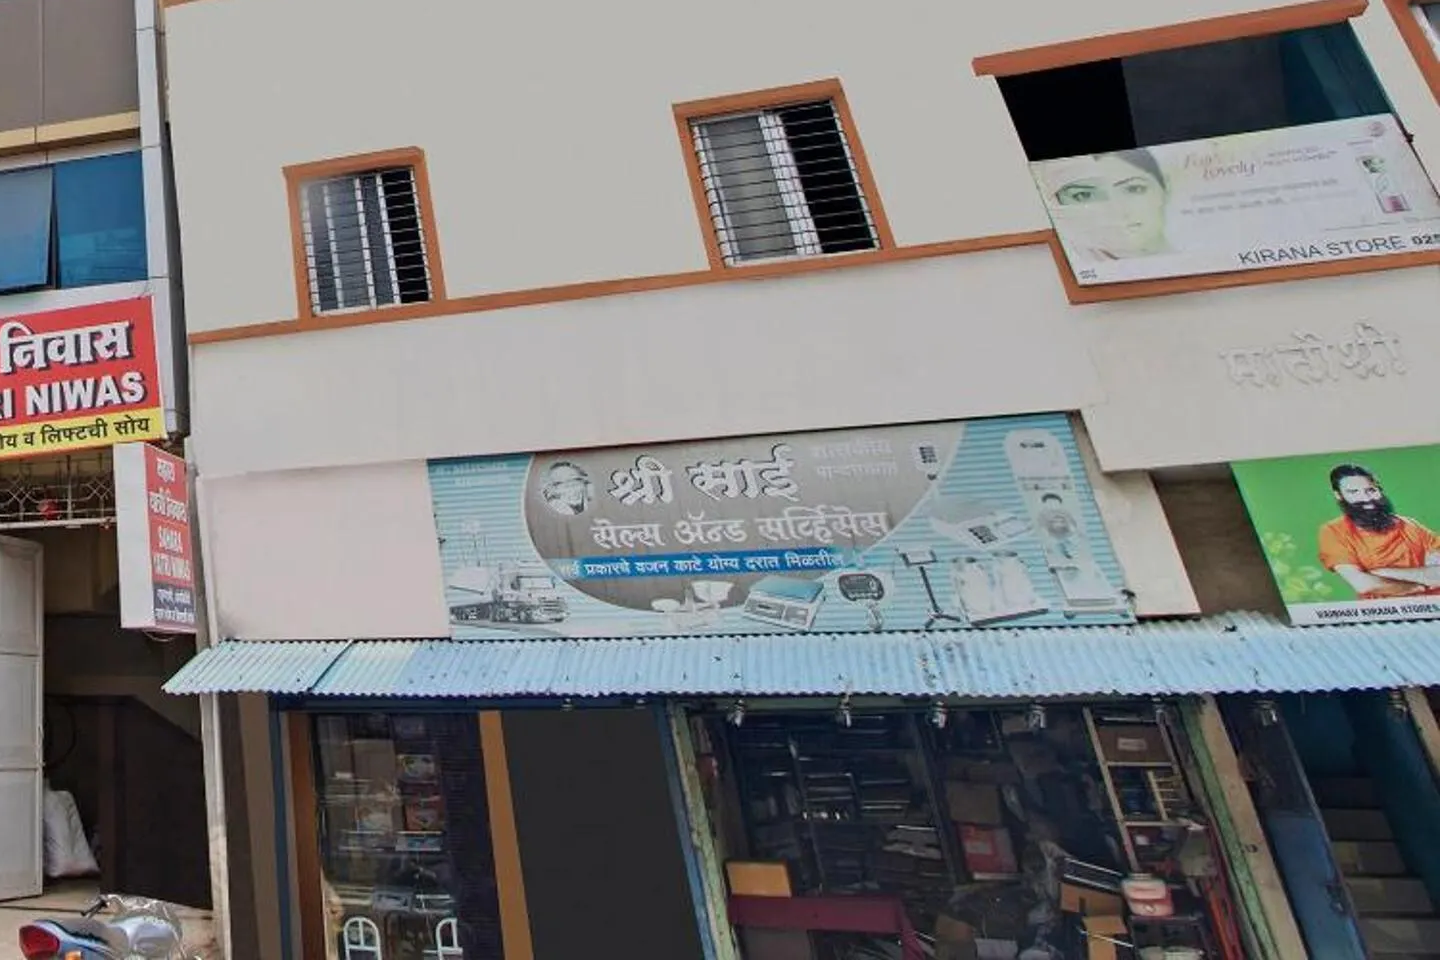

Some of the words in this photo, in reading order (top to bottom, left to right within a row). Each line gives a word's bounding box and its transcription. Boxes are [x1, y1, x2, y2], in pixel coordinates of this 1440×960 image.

[1238, 243, 1321, 265] KIRANA
[1327, 236, 1407, 257] STORE
[25, 371, 146, 417] NIWAS
[24, 431, 35, 446] व
[40, 417, 108, 445] लिफ्टची
[113, 415, 150, 436] सोय
[608, 454, 673, 506] श्री
[685, 443, 800, 502] साई
[590, 517, 665, 549] सेल्स
[673, 555, 703, 571] काटे
[708, 554, 740, 571] योग्य
[744, 555, 779, 571] दरात
